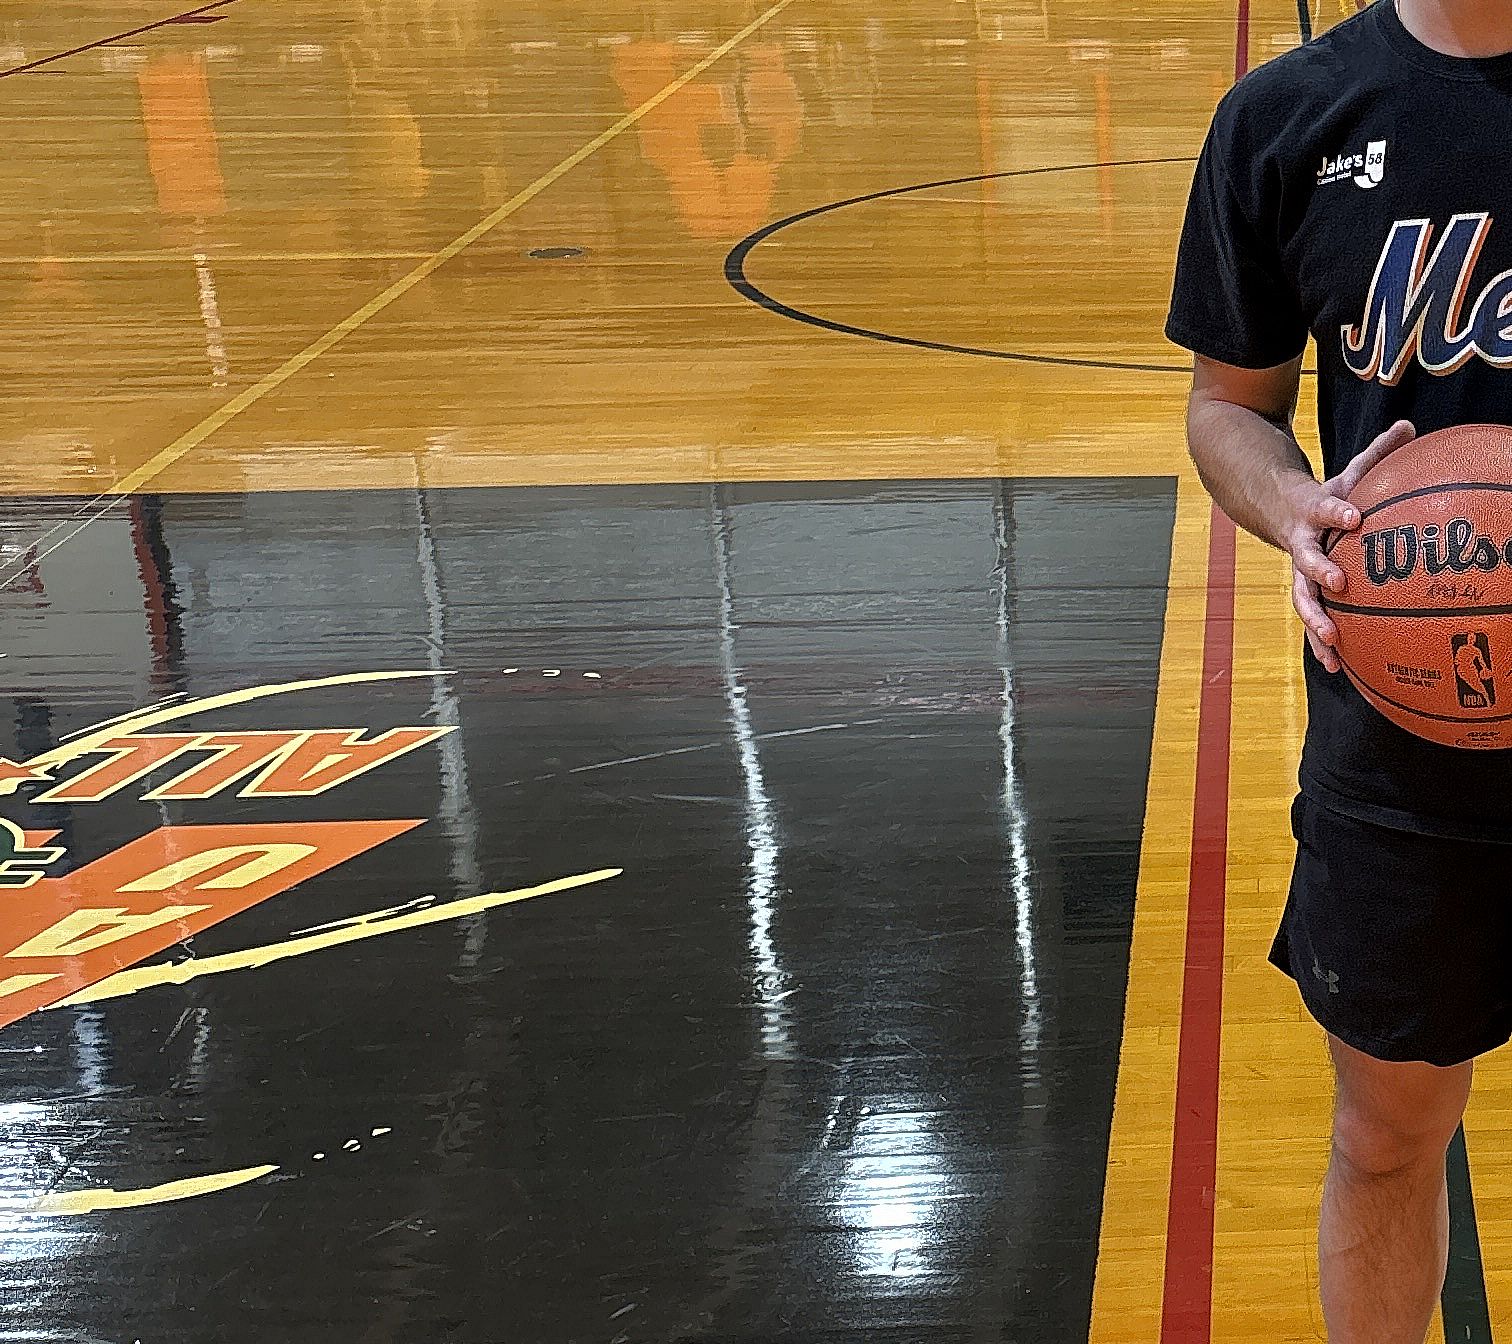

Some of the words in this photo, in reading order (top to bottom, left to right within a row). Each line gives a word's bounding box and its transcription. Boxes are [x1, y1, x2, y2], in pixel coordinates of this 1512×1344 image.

[1317, 154, 1364, 177] Jake's
[1368, 153, 1383, 165] 58
[30, 725, 459, 804] ALL
